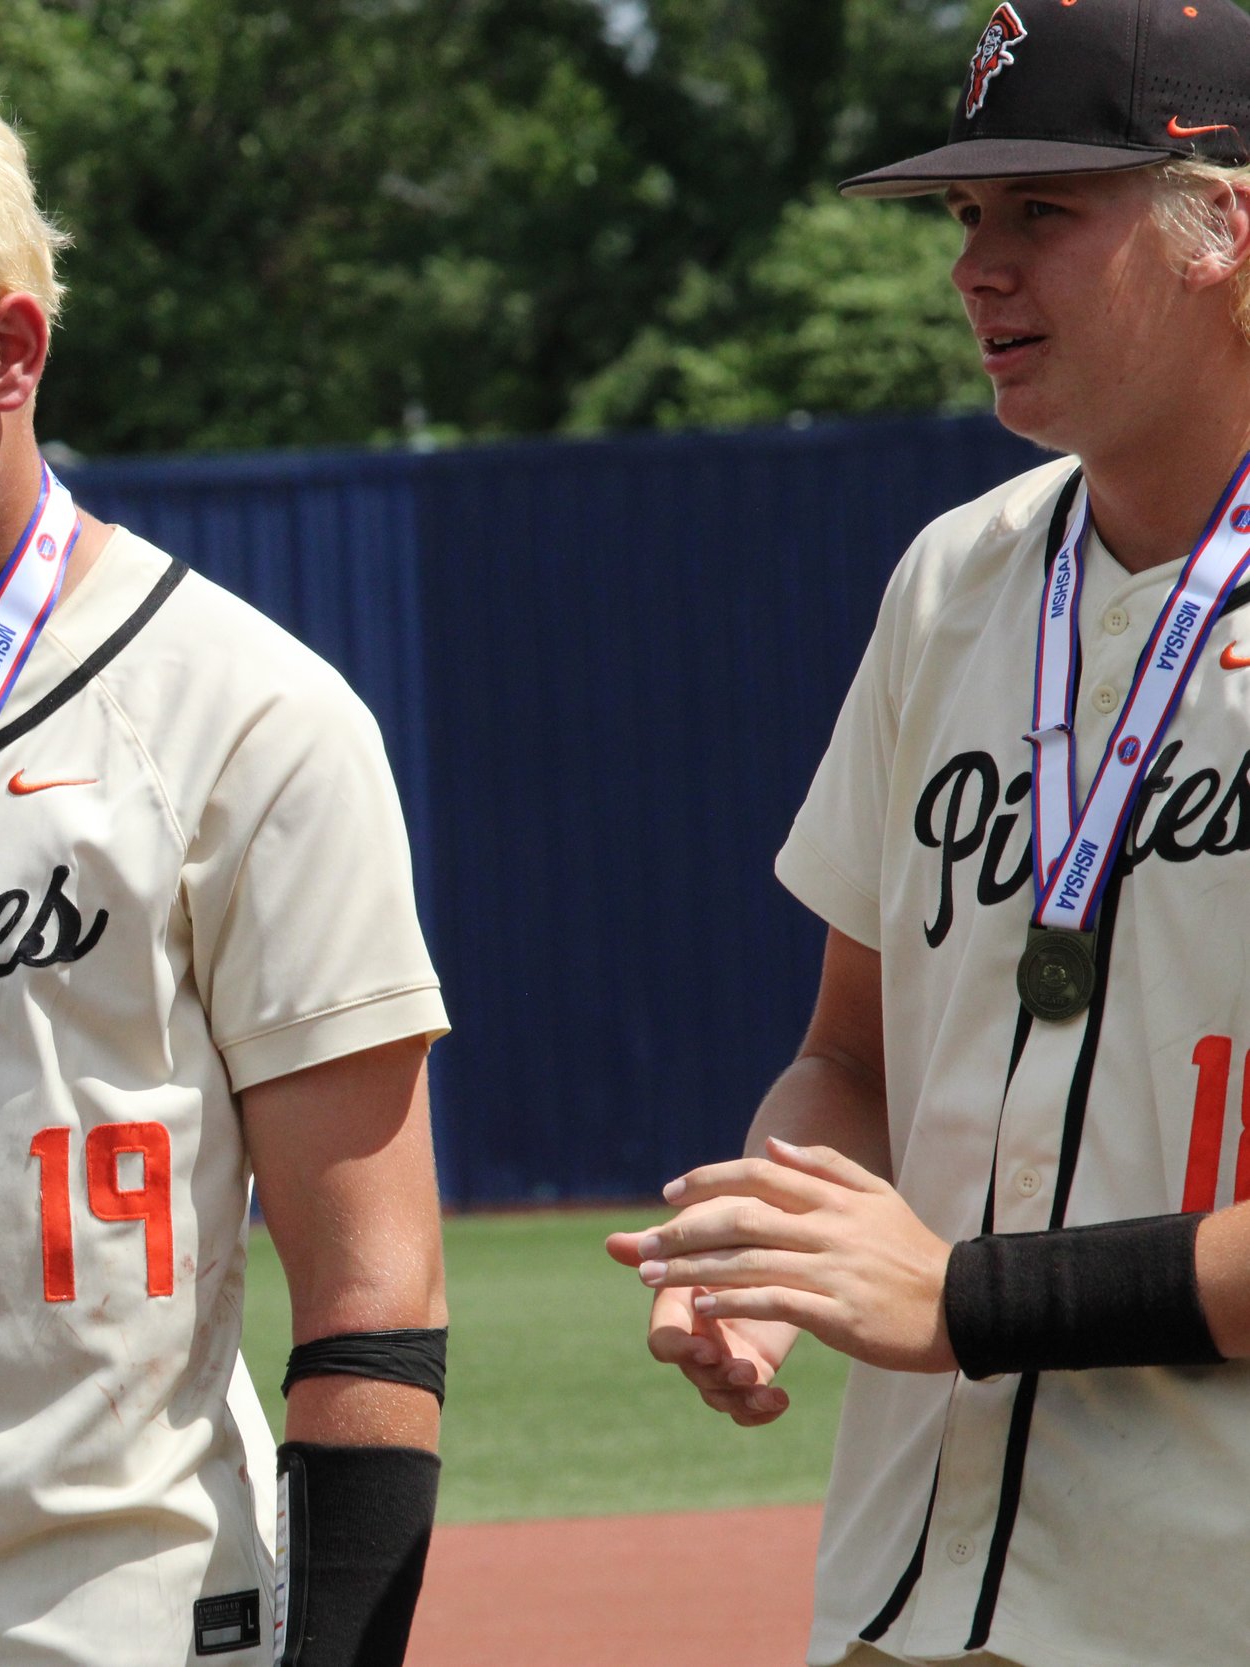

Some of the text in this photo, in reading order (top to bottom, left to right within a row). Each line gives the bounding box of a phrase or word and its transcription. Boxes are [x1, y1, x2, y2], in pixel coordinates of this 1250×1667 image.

[1051, 547, 1071, 619] MSHSAA
[1156, 600, 1201, 671] MSHSAA
[1055, 838, 1099, 911] MSHSAA
[1181, 1034, 1250, 1213] 1
[30, 1121, 174, 1302] 19
